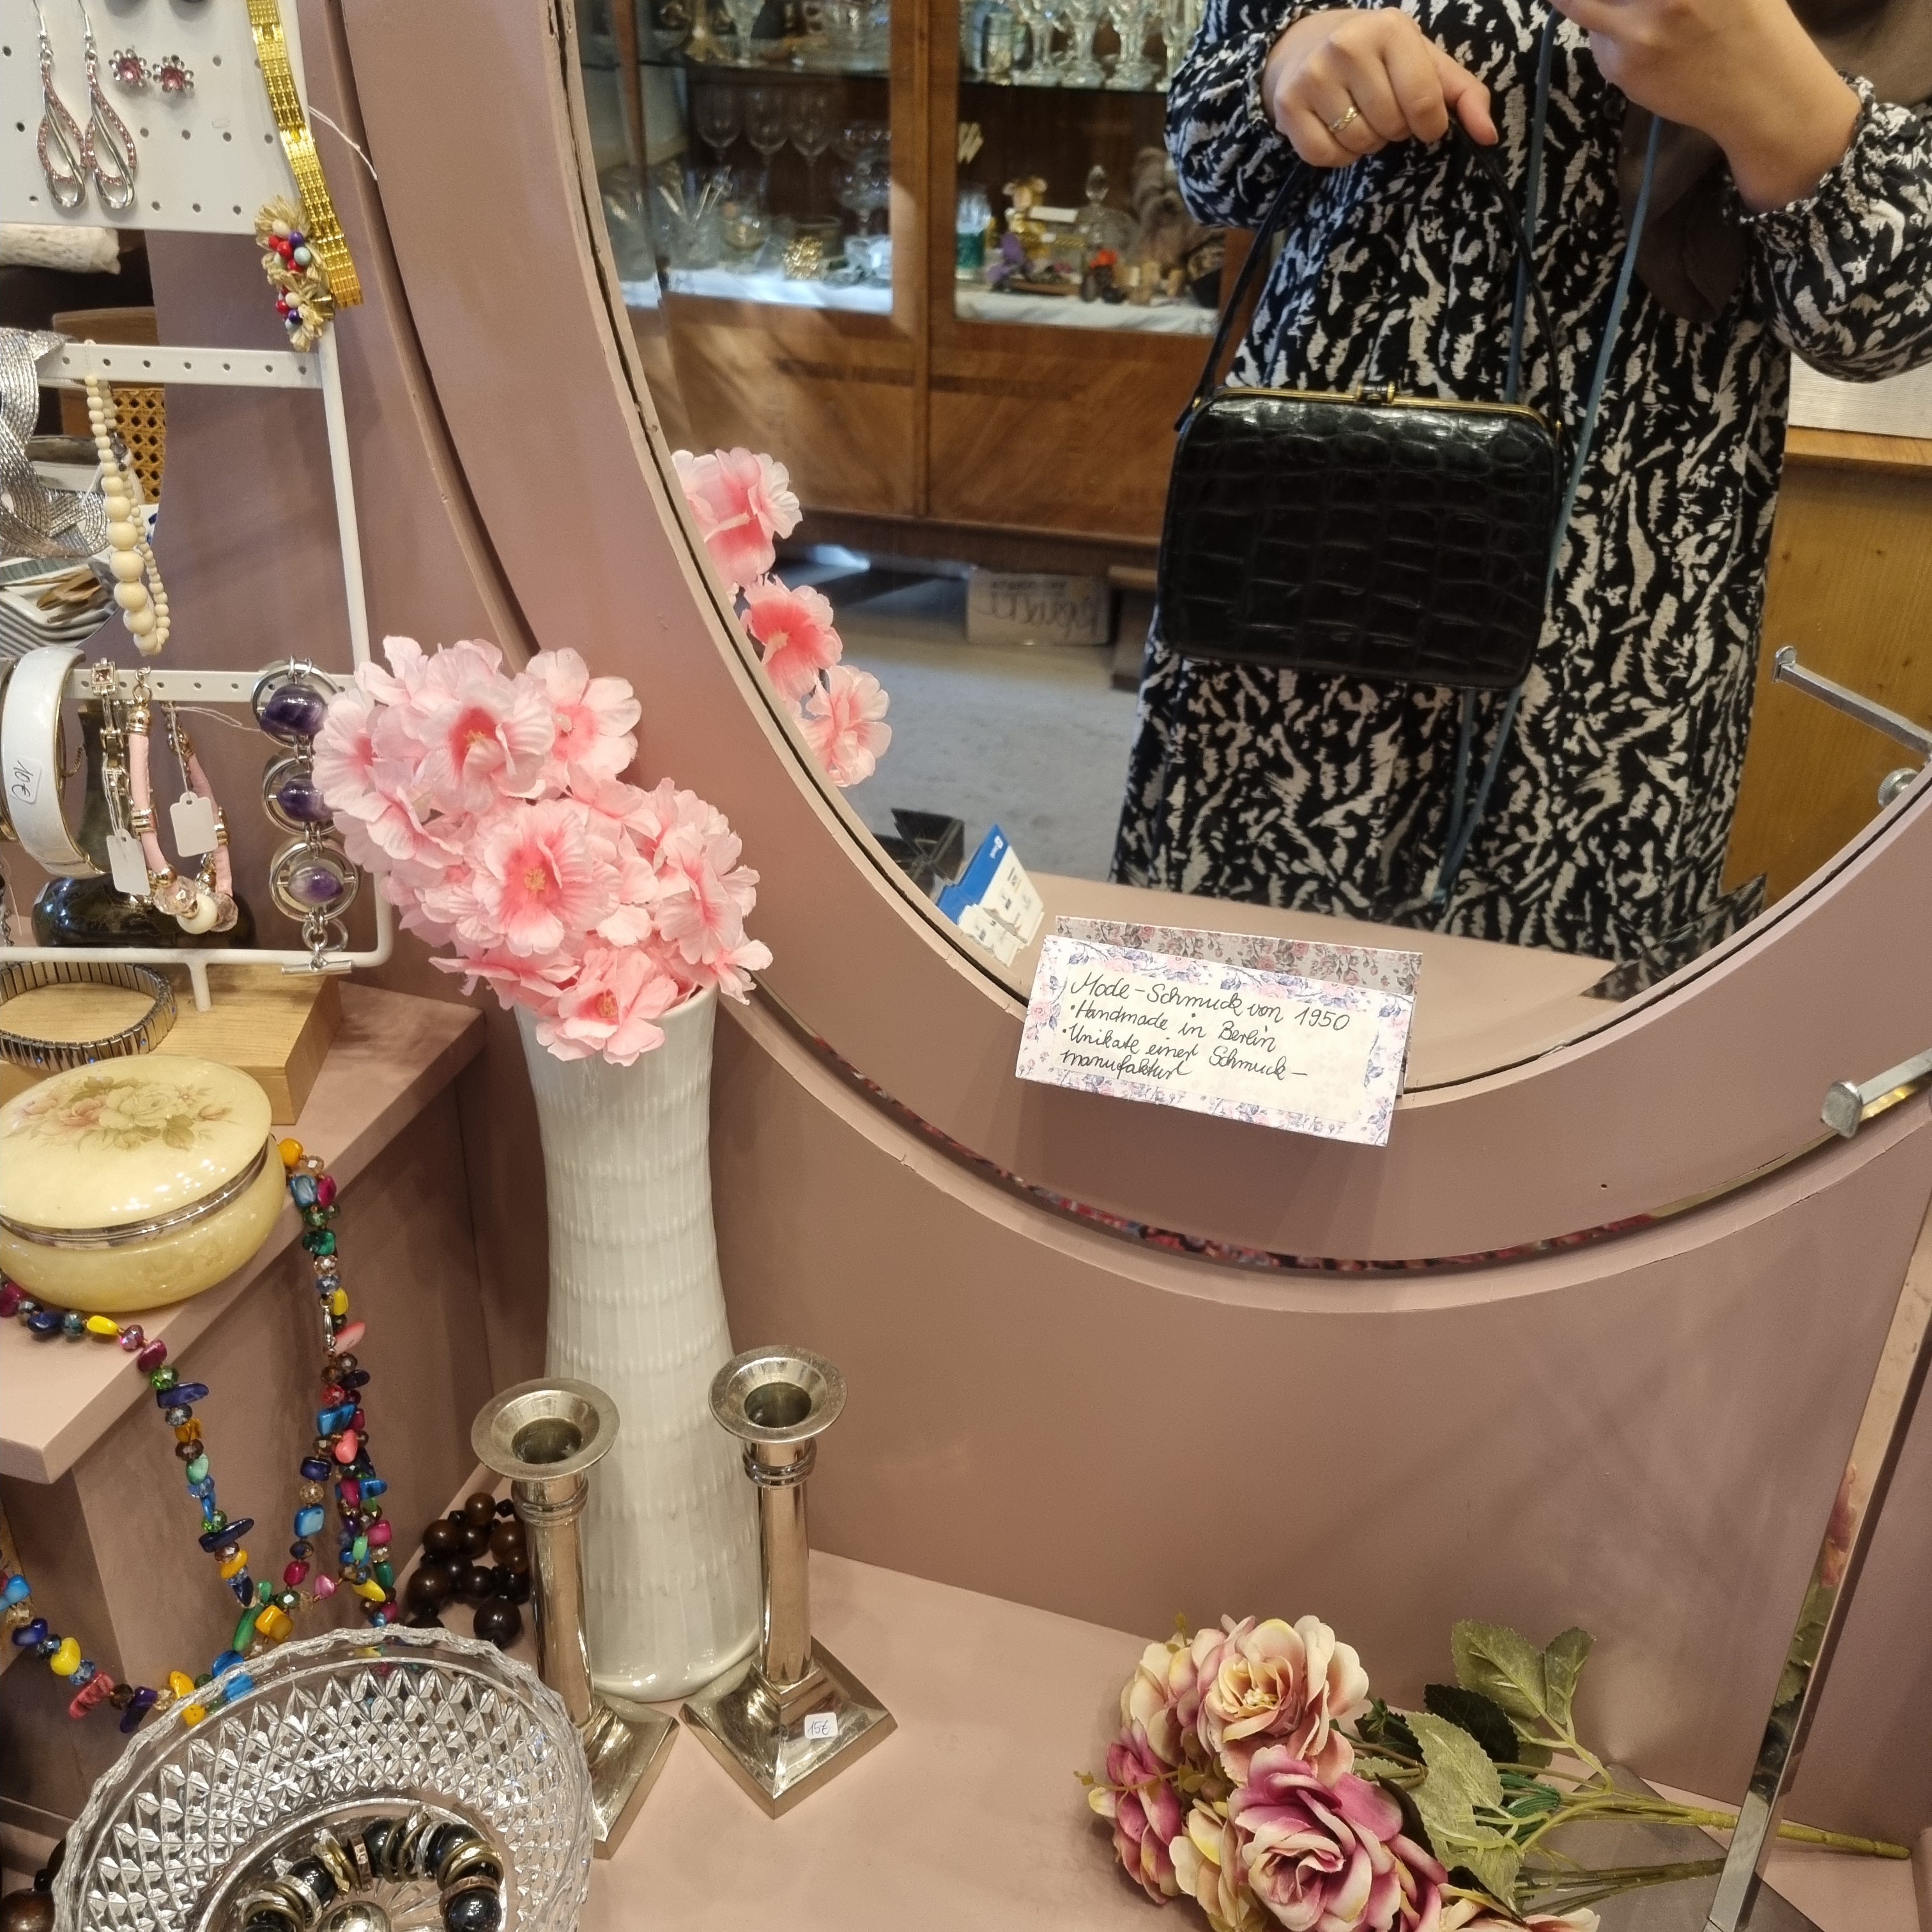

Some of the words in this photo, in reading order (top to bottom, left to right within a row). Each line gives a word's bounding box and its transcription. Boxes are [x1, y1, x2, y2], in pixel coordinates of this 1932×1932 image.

[1075, 1000, 1168, 1030] Handmade
[1177, 1013, 1206, 1038] in
[1218, 1020, 1276, 1052] Berlin
[1247, 1004, 1284, 1023] von
[1294, 1007, 1350, 1031] 1950
[1069, 1023, 1140, 1054] Unikate
[1145, 1038, 1199, 1061] einer
[1061, 1050, 1192, 1080] manufaktur
[808, 1720, 830, 1735] 15€
